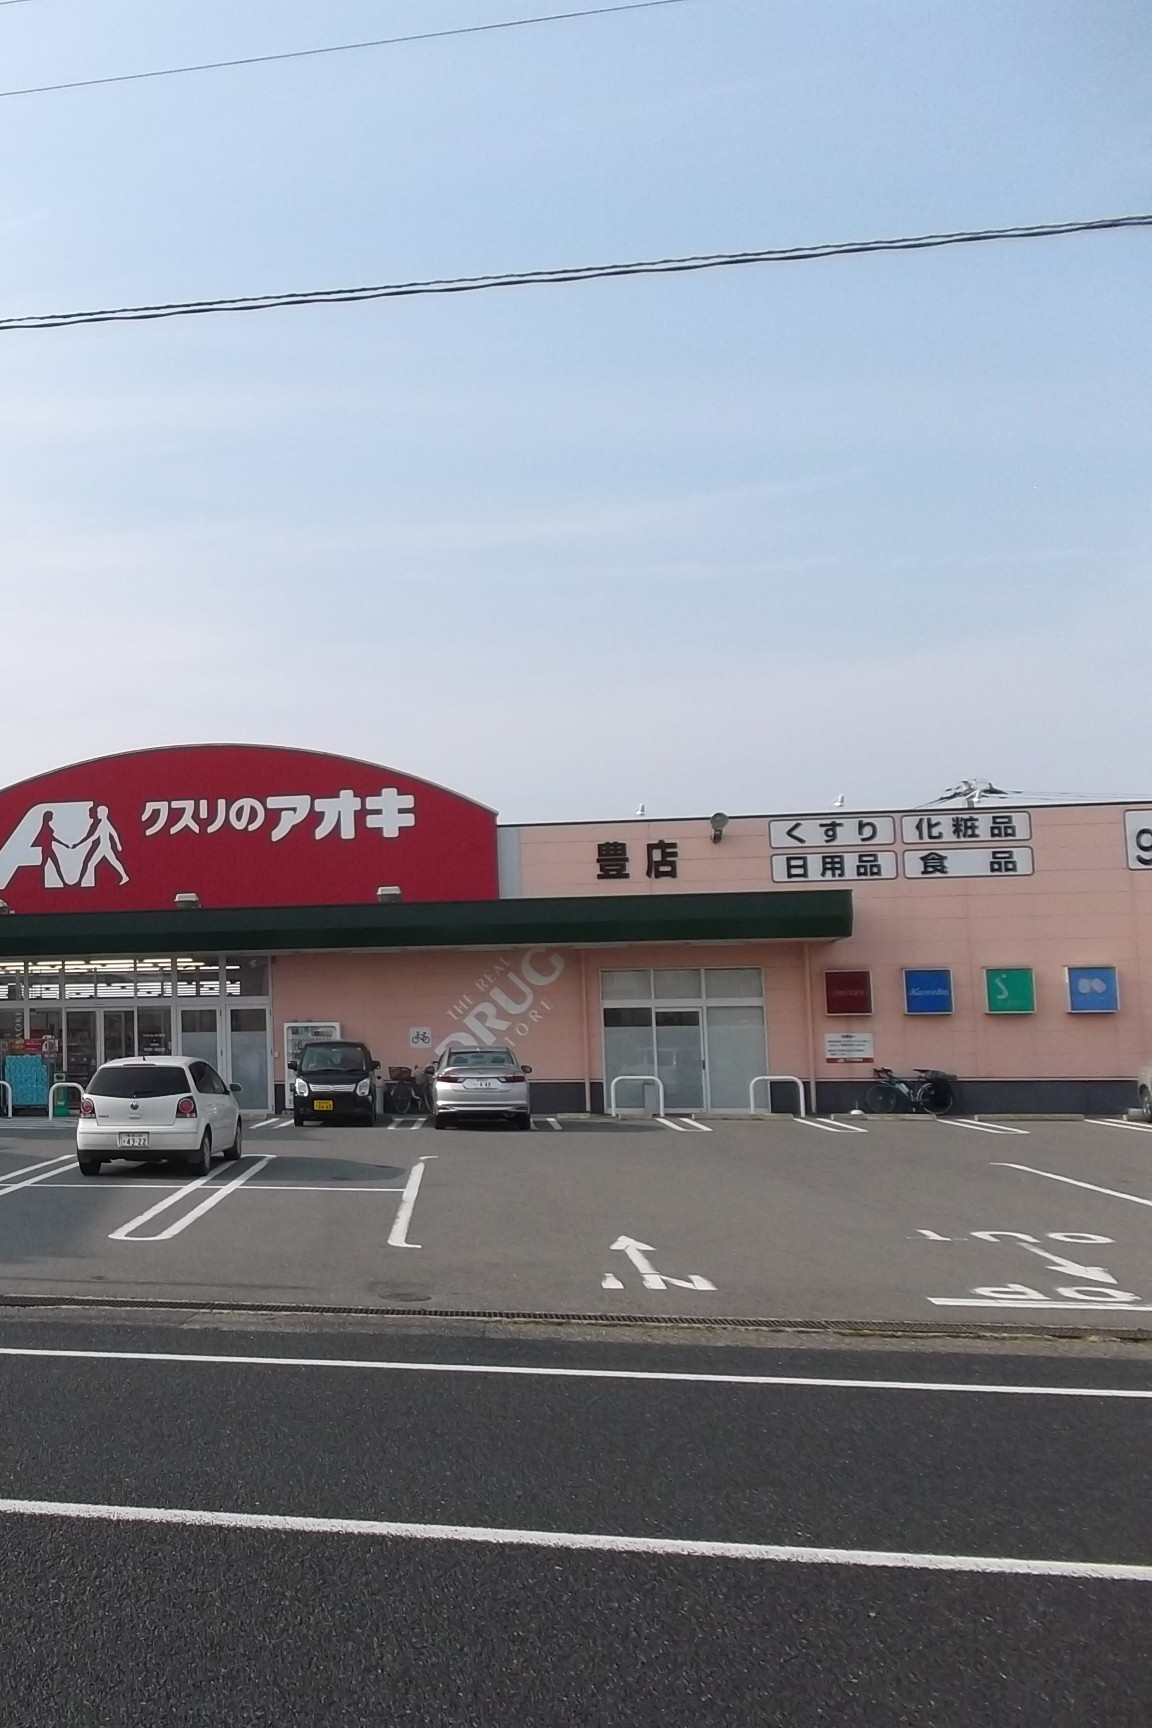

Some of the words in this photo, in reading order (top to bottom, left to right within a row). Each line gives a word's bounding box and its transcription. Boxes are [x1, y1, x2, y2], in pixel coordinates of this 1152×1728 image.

[141, 787, 415, 842] クスリのアオキ
[785, 819, 878, 844] くすり
[915, 815, 1017, 841] 化粧品
[596, 840, 679, 880] 豊店
[786, 854, 883, 880] 日用品
[919, 850, 1018, 876] 食品
[504, 996, 555, 1048] TORE
